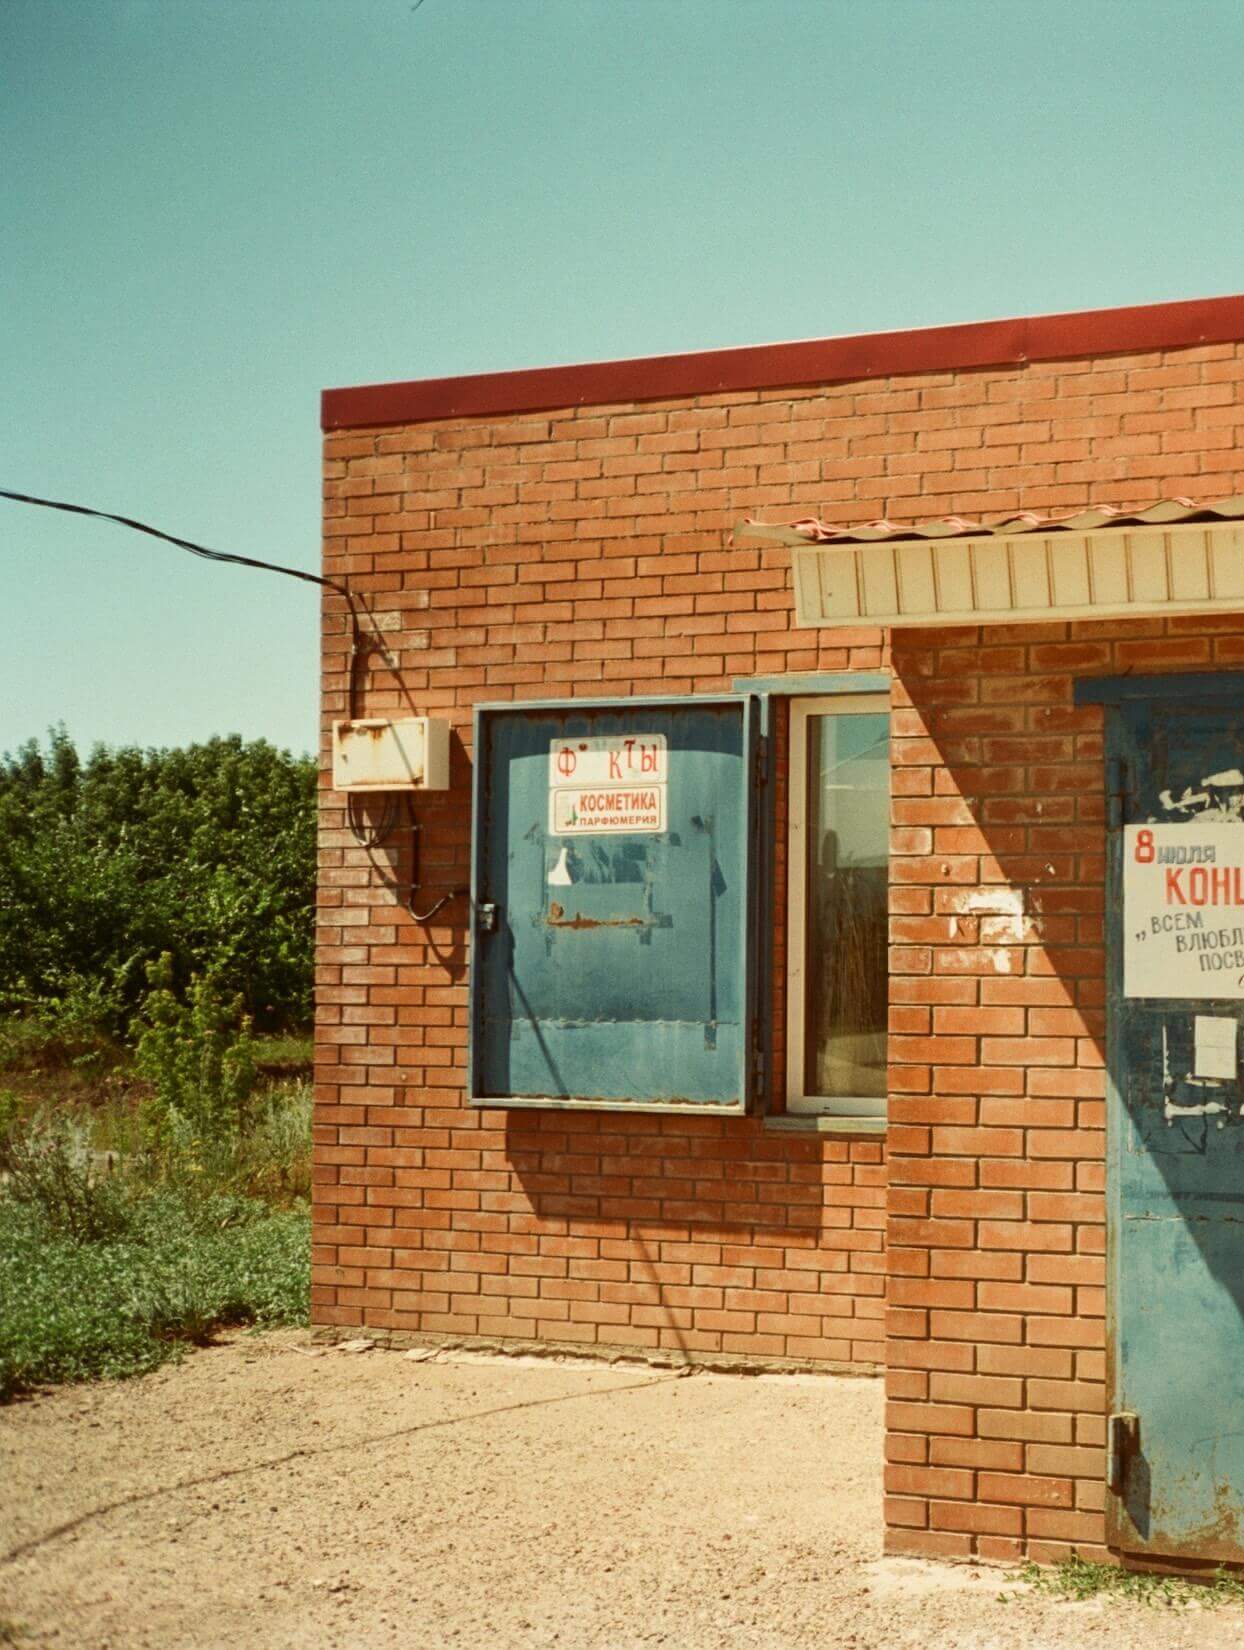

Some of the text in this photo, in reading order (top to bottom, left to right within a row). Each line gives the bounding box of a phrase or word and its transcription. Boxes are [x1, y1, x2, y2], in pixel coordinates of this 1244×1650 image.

[579, 792, 657, 812] КОСМЕТИКА
[579, 815, 657, 826] ПАРФЮМЕРИЯ
[1134, 829, 1155, 864] 8
